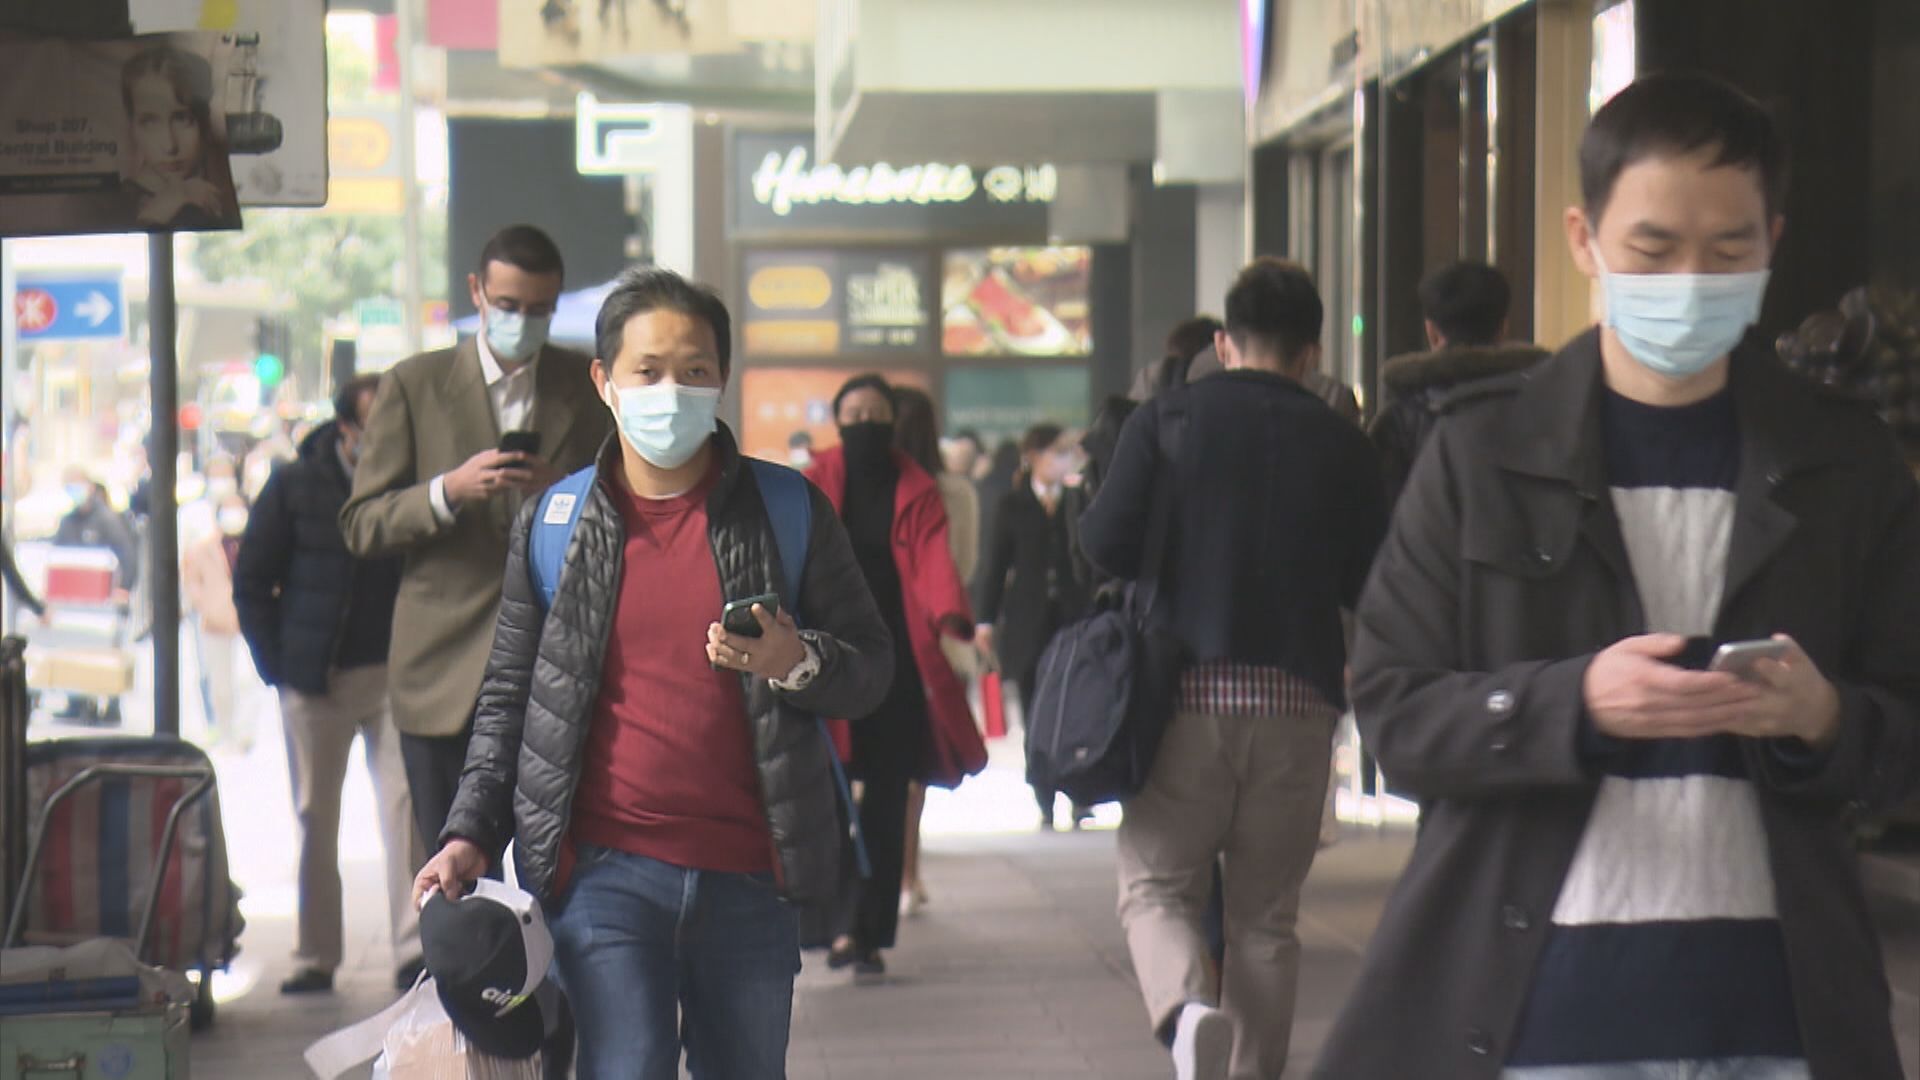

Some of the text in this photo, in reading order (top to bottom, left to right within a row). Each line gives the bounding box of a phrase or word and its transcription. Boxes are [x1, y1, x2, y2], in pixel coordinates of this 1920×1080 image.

[16, 118, 57, 135] Shop
[0, 139, 118, 156] entral Building
